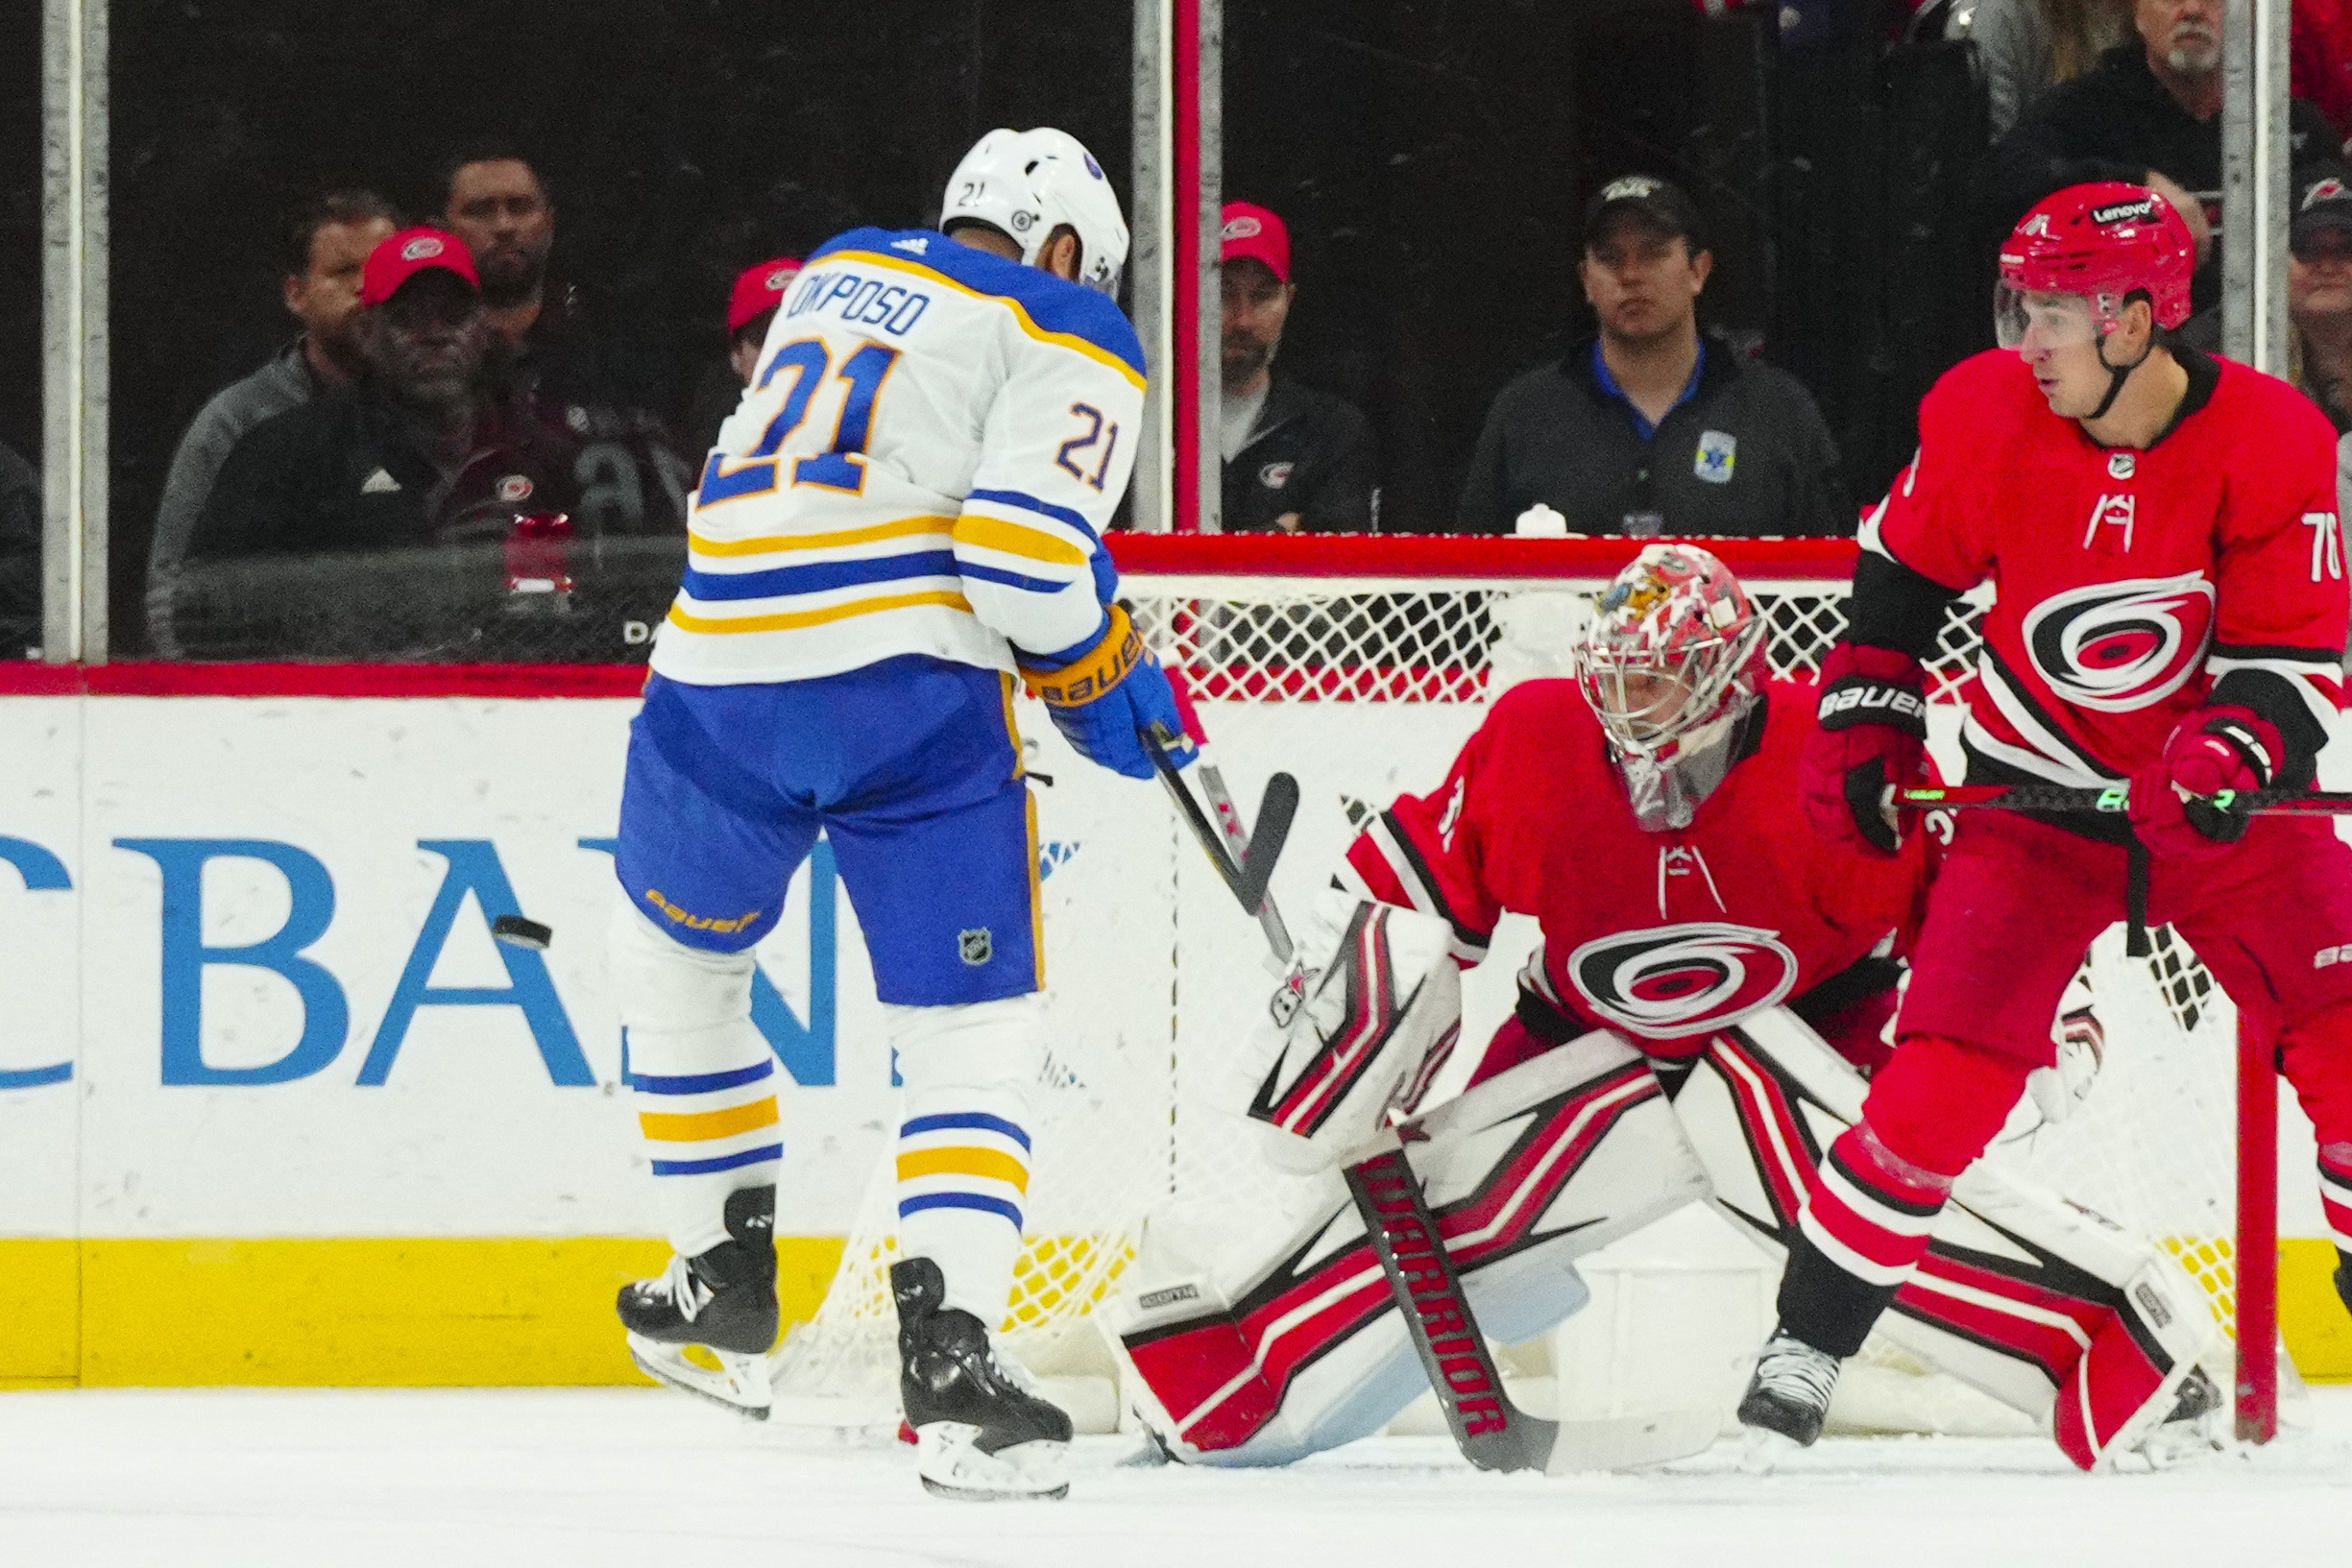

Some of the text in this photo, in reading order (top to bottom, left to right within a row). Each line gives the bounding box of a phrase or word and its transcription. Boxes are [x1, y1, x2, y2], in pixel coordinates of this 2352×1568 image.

[958, 181, 985, 206] 21
[2093, 202, 2150, 223] Lenovo
[788, 272, 930, 336] OKPOSO
[694, 335, 903, 513] 21
[1054, 400, 1119, 494] 21
[1357, 1155, 1507, 1437] WARRIOR
